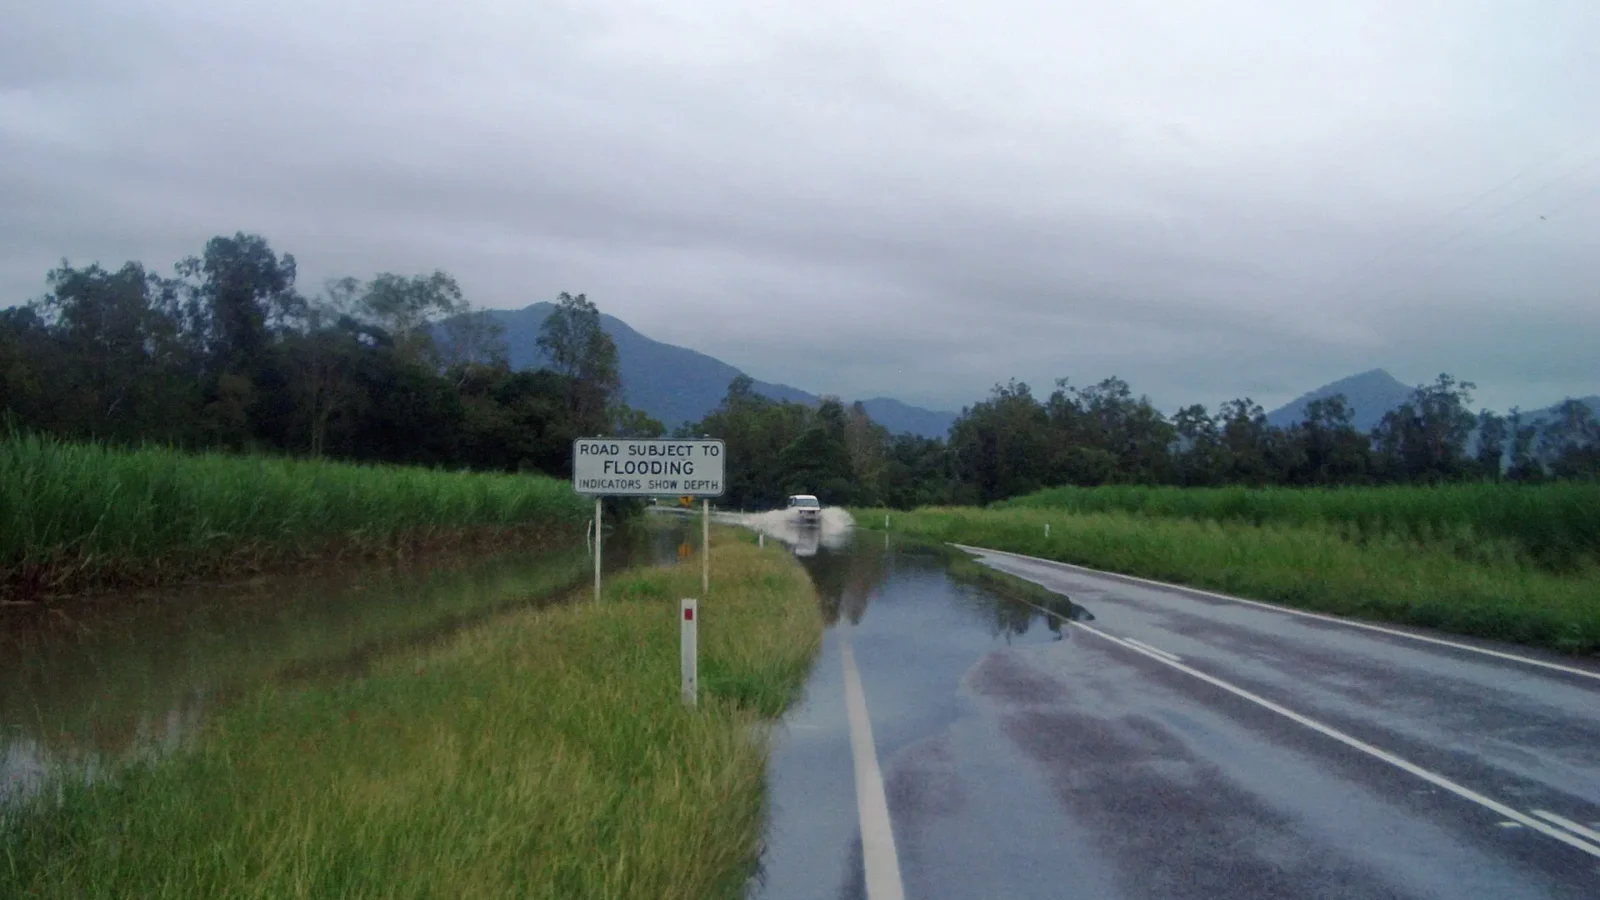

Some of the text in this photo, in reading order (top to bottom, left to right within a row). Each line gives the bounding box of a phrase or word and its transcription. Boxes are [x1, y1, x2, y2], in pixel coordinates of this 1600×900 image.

[580, 444, 719, 456] ROAD SUBJECT TO
[603, 460, 694, 475] FLOODING
[579, 479, 718, 490] INDICATORS SHOW DEPTH
